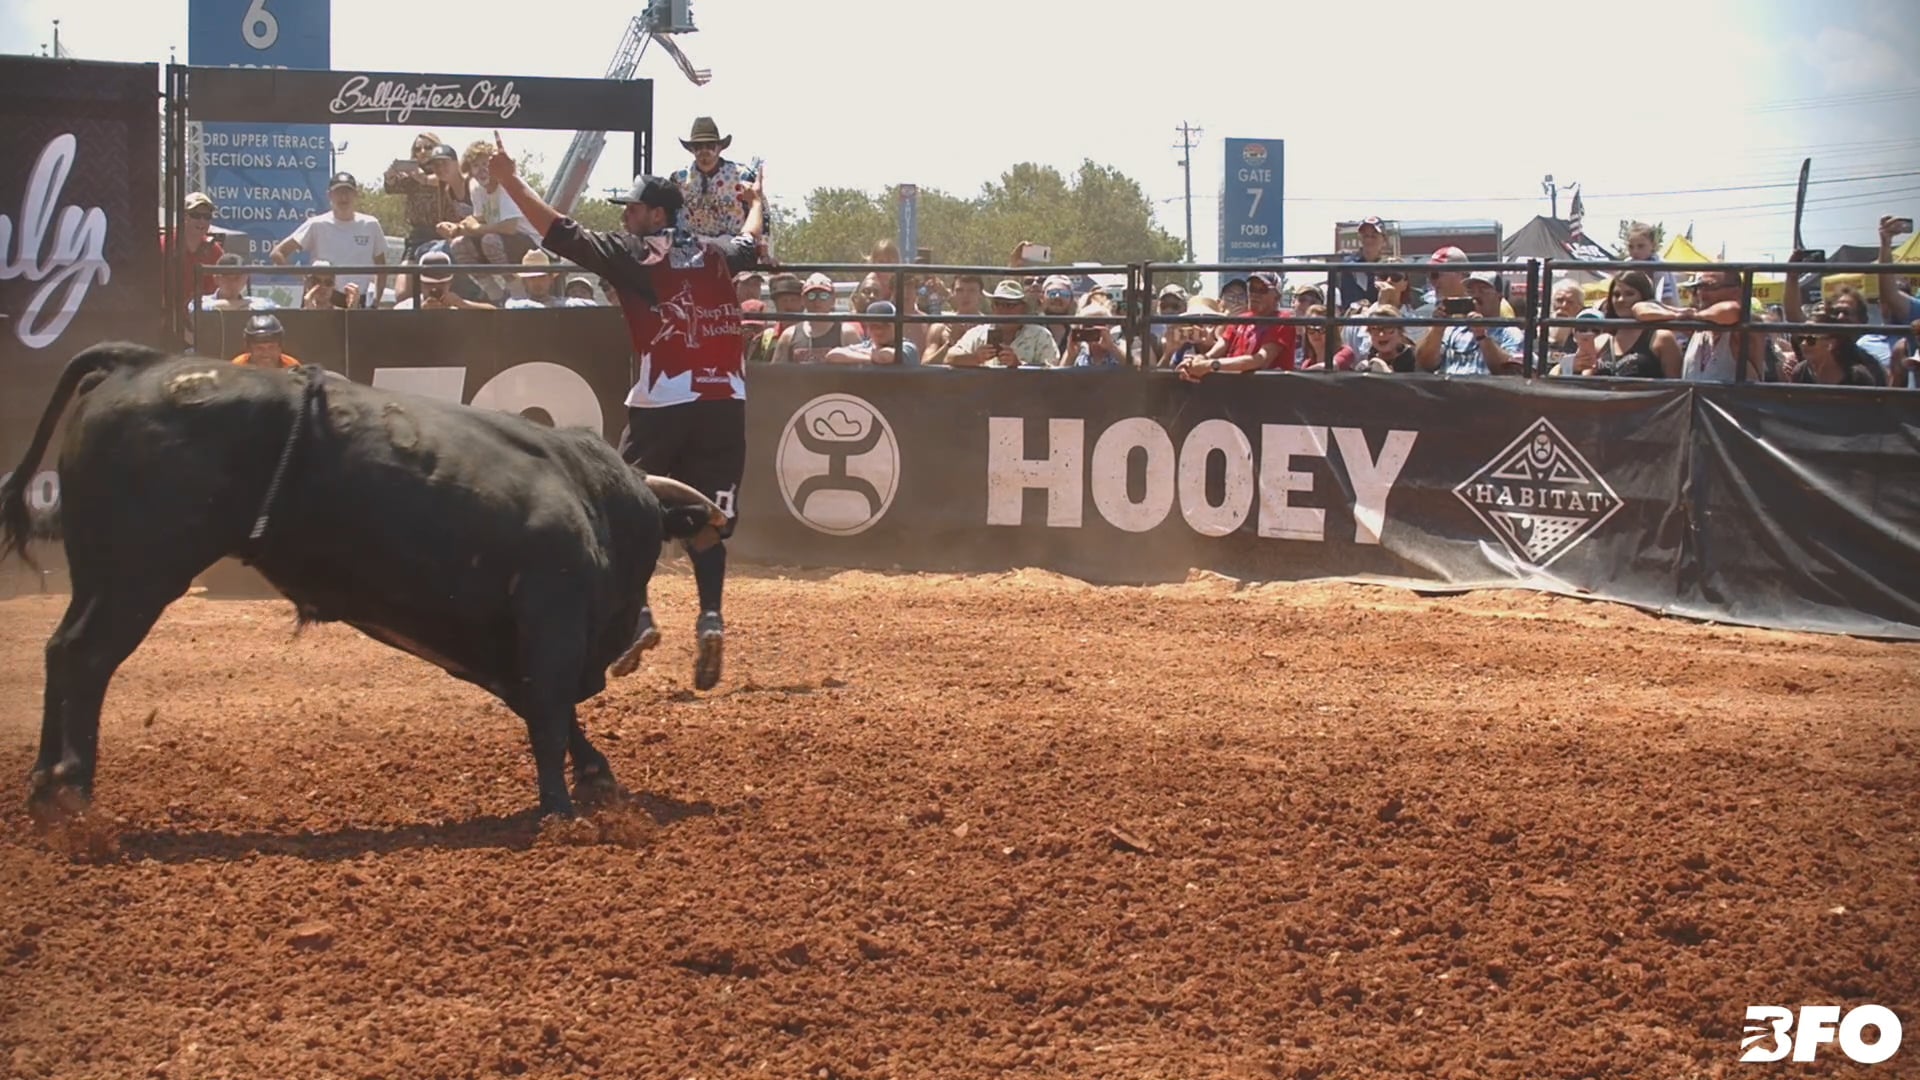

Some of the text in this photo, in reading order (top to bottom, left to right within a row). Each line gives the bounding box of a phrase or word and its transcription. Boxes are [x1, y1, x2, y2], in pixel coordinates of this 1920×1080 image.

[242, 0, 278, 50] 6
[329, 76, 521, 123] Bullfighters Only
[203, 133, 325, 149] ORD UPPER TERRACE
[205, 153, 317, 169] SECTIONS AA-G
[1238, 169, 1272, 183] GATE
[207, 186, 313, 201] NEW VERANDA
[1247, 188, 1263, 218] 7
[212, 206, 272, 220] ECTIONS
[1240, 225, 1268, 236] FORD
[987, 416, 1419, 545] HOOEY
[1475, 484, 1602, 512] HABITAT
